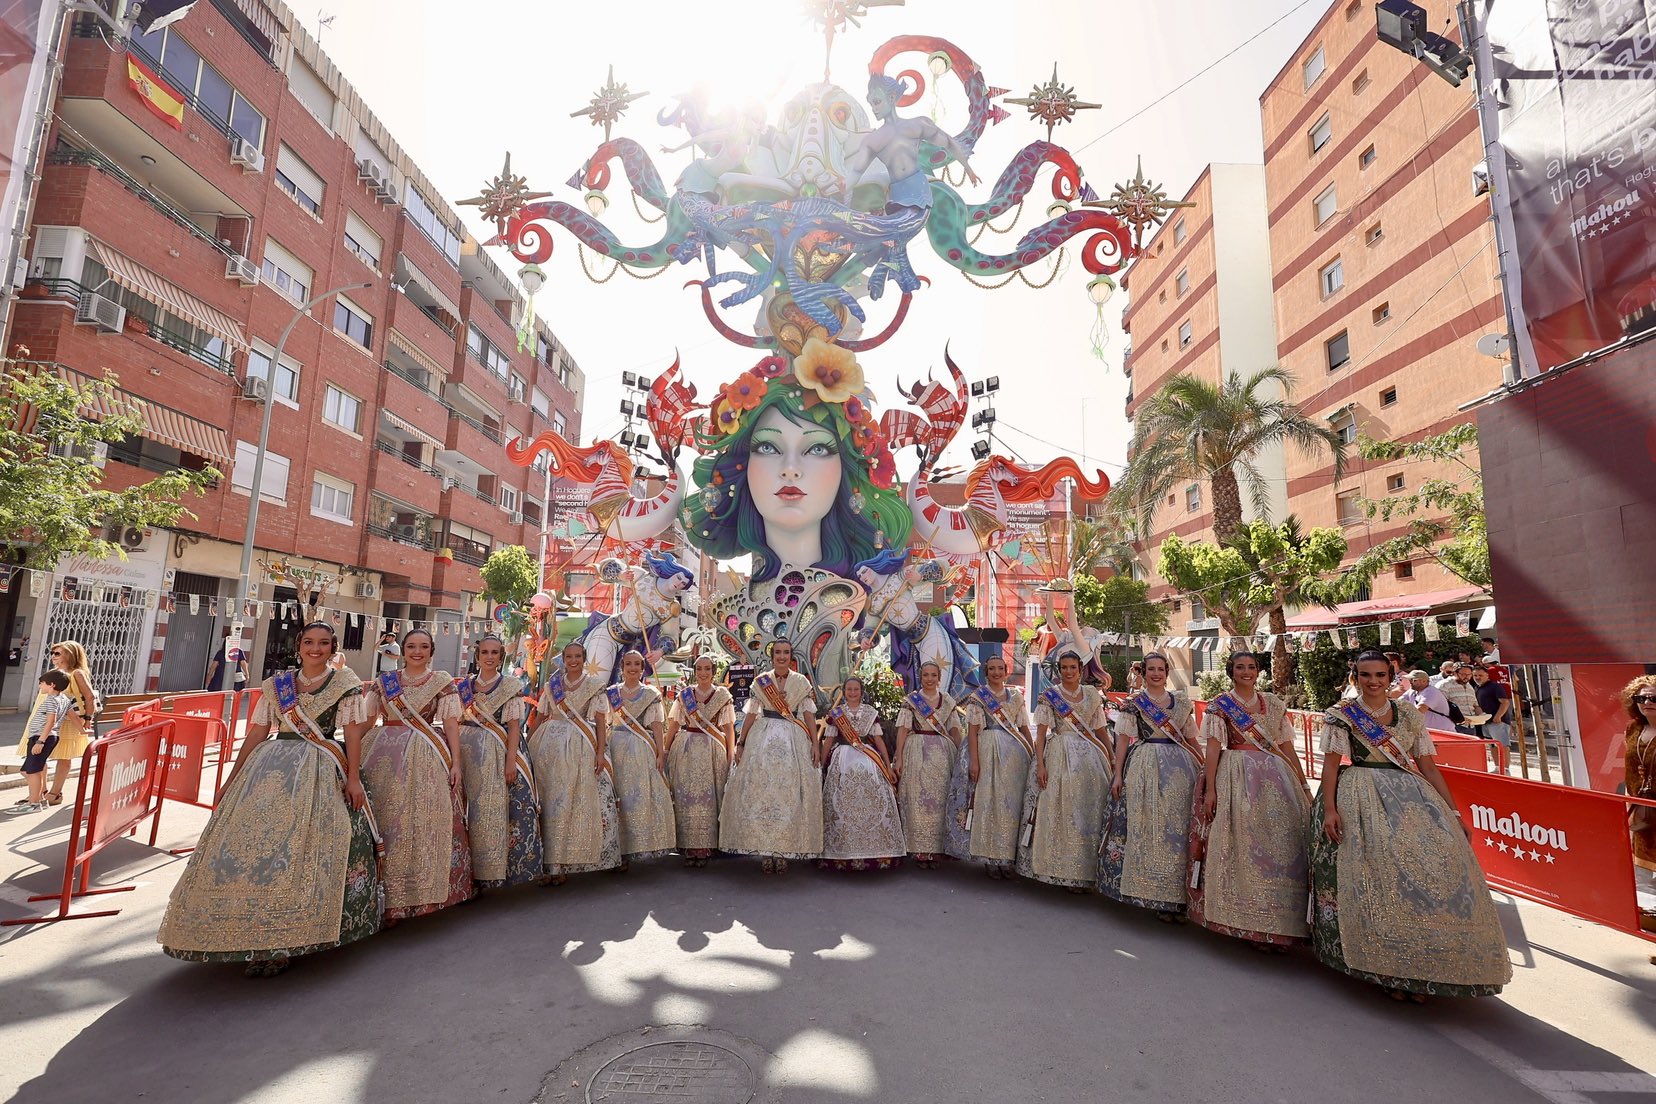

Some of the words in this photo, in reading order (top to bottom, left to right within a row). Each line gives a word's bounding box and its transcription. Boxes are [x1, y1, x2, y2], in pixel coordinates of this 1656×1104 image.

[1550, 147, 1625, 205] that's
[1570, 189, 1641, 238] Mahou
[110, 756, 148, 795] Mahou
[1469, 803, 1569, 852] Mahou
